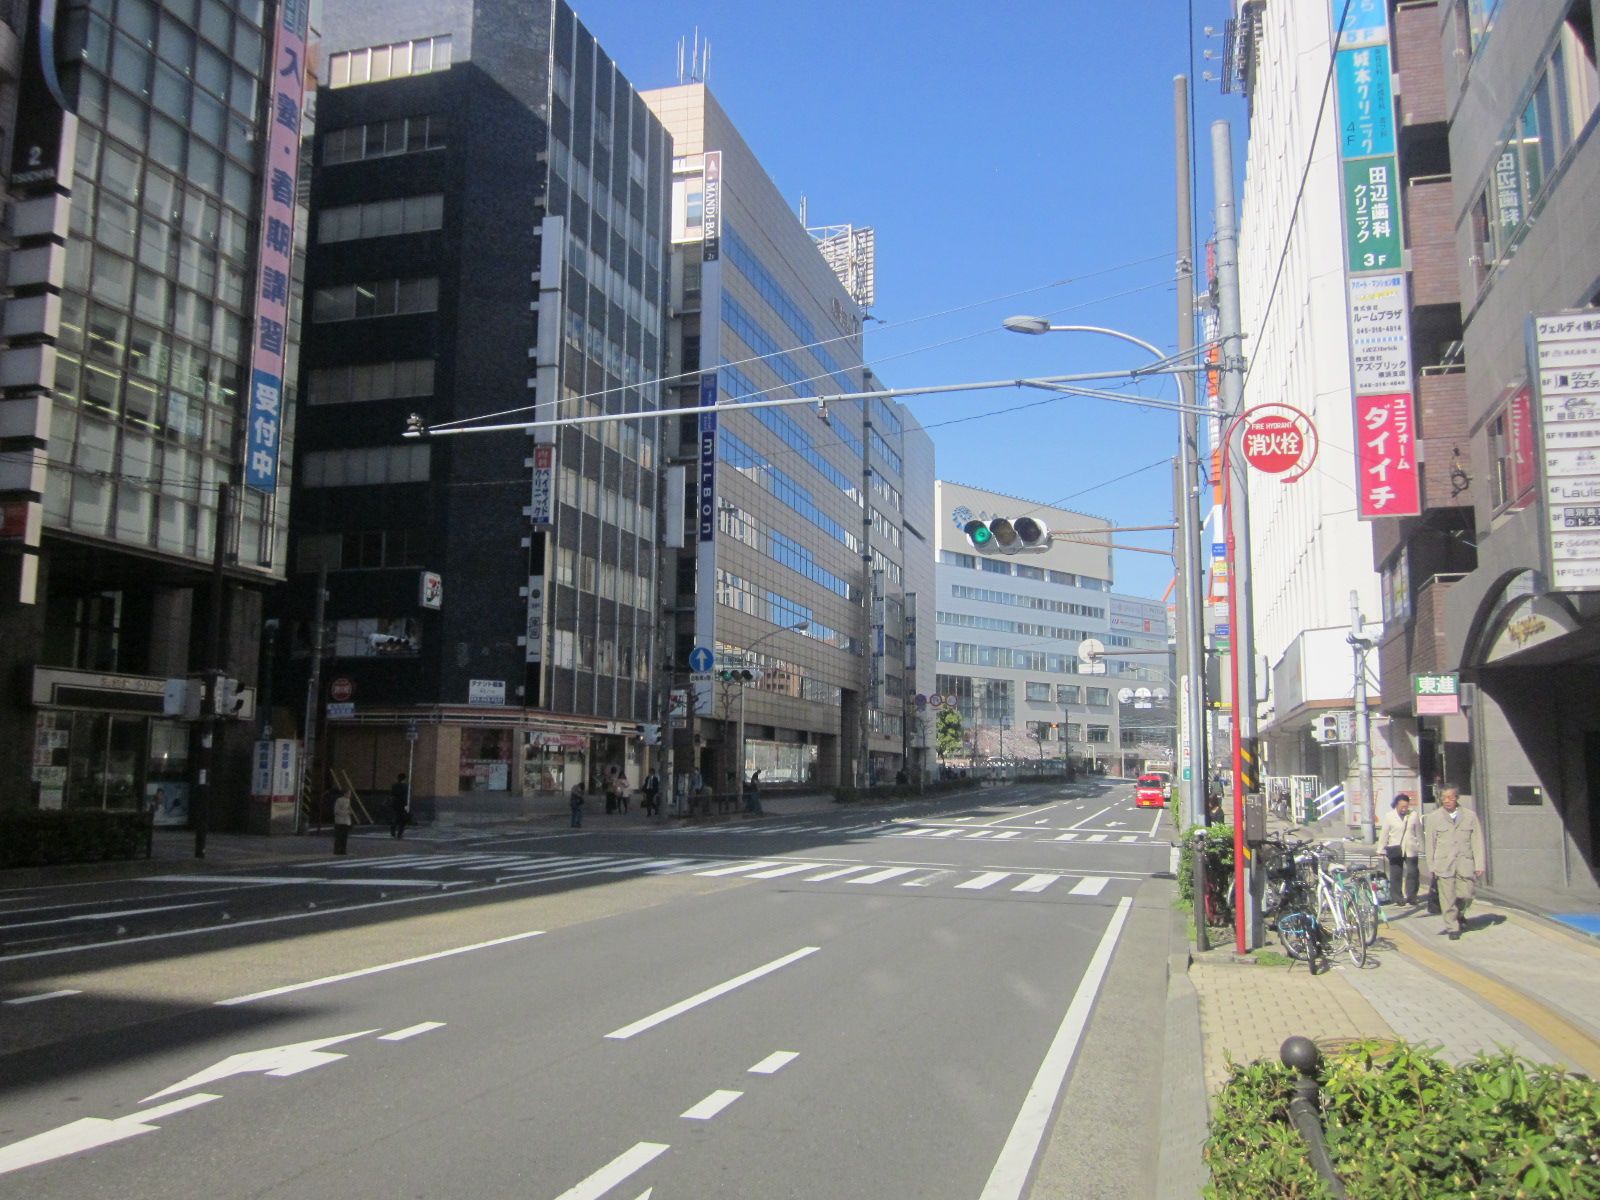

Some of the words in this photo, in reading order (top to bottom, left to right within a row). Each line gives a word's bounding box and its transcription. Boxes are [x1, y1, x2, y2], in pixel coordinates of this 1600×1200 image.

[1354, 184, 1370, 244] クリニック
[1369, 166, 1391, 239] 田辺歯科
[1351, 277, 1401, 290] アパート・マンション
[1353, 308, 1403, 323] ルームプラザ
[1356, 360, 1407, 373] アズ・ブリック
[1571, 379, 1600, 389] エステ
[252, 382, 279, 479] 受付中
[1265, 421, 1293, 430] HYDRANT
[1393, 398, 1411, 470] ユニフォーム
[1247, 432, 1300, 457] 消火栓
[1363, 403, 1397, 510] ダイイチ
[534, 469, 543, 517] クリニック
[1417, 675, 1455, 694] 東進
